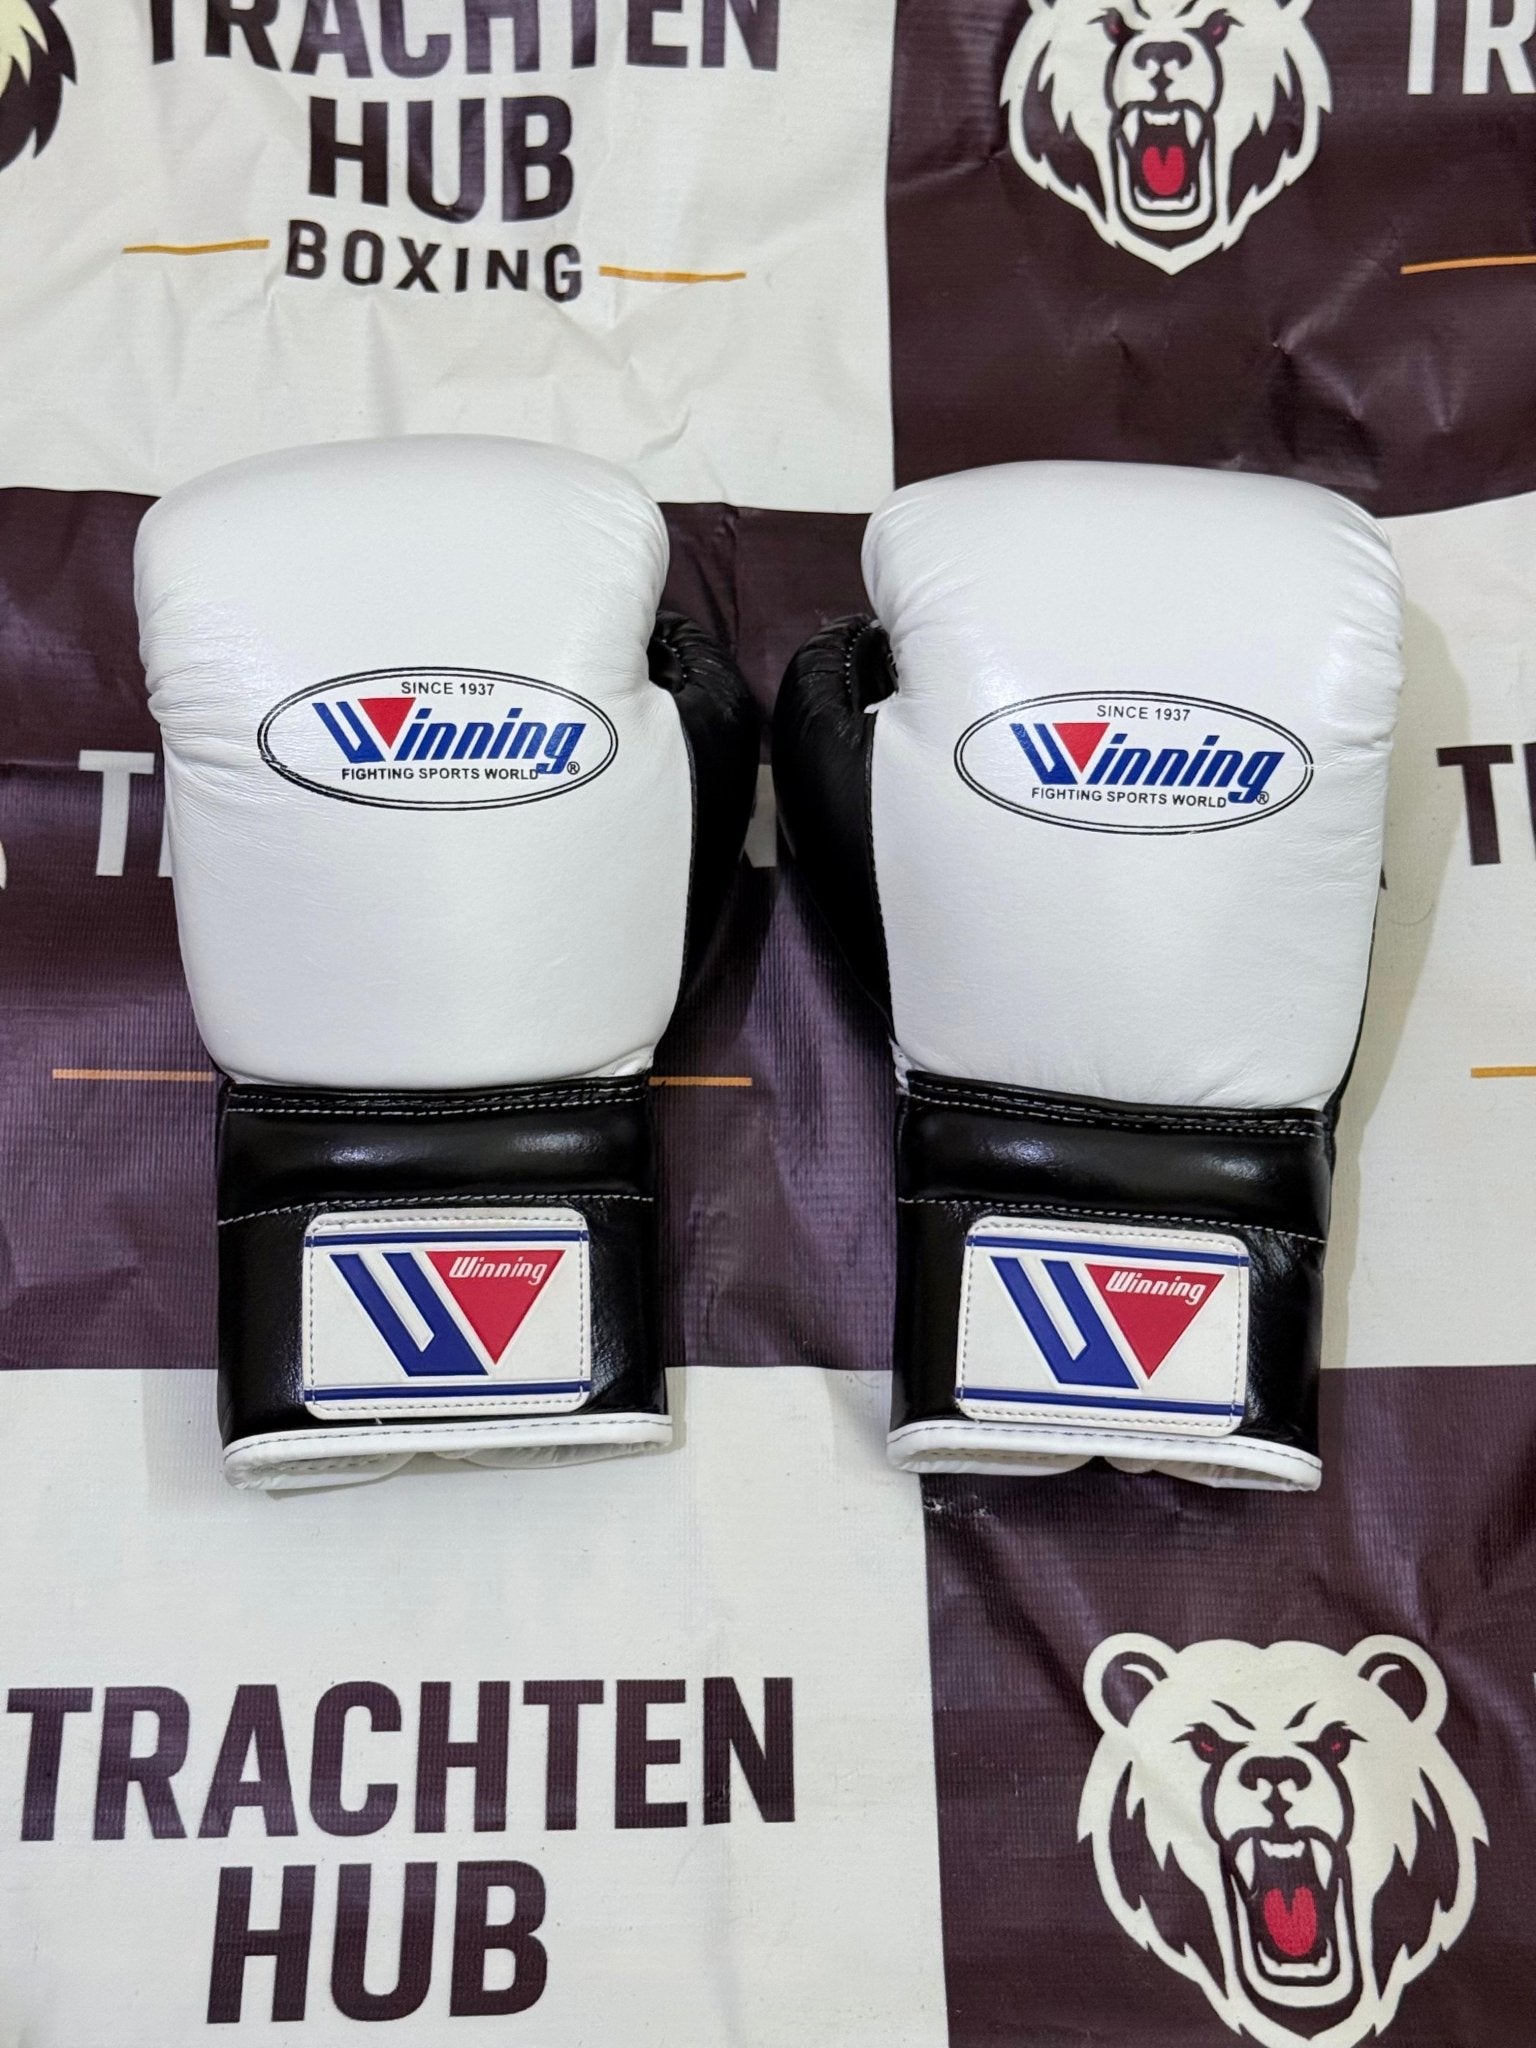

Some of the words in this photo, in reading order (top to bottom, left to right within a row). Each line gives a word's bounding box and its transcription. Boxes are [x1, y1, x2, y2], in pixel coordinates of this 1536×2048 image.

[308, 94, 574, 224] HUB
[285, 218, 583, 303] BOXING
[400, 681, 454, 696] SINCE
[459, 682, 495, 697] 1937
[1096, 704, 1149, 720] SINCE
[1155, 707, 1191, 722] 1937
[341, 767, 415, 781] FIGHTING
[418, 768, 481, 781] SPORTS
[484, 768, 540, 781] WORLD
[1031, 786, 1103, 803] FIGHTING
[1106, 790, 1168, 806] SPORTS
[1172, 793, 1227, 809] WORLD
[448, 1255, 548, 1286] Winning
[1105, 1270, 1207, 1305] Winning
[6, 1676, 796, 1842] TRACHTEN
[206, 1860, 548, 2025] HUB
